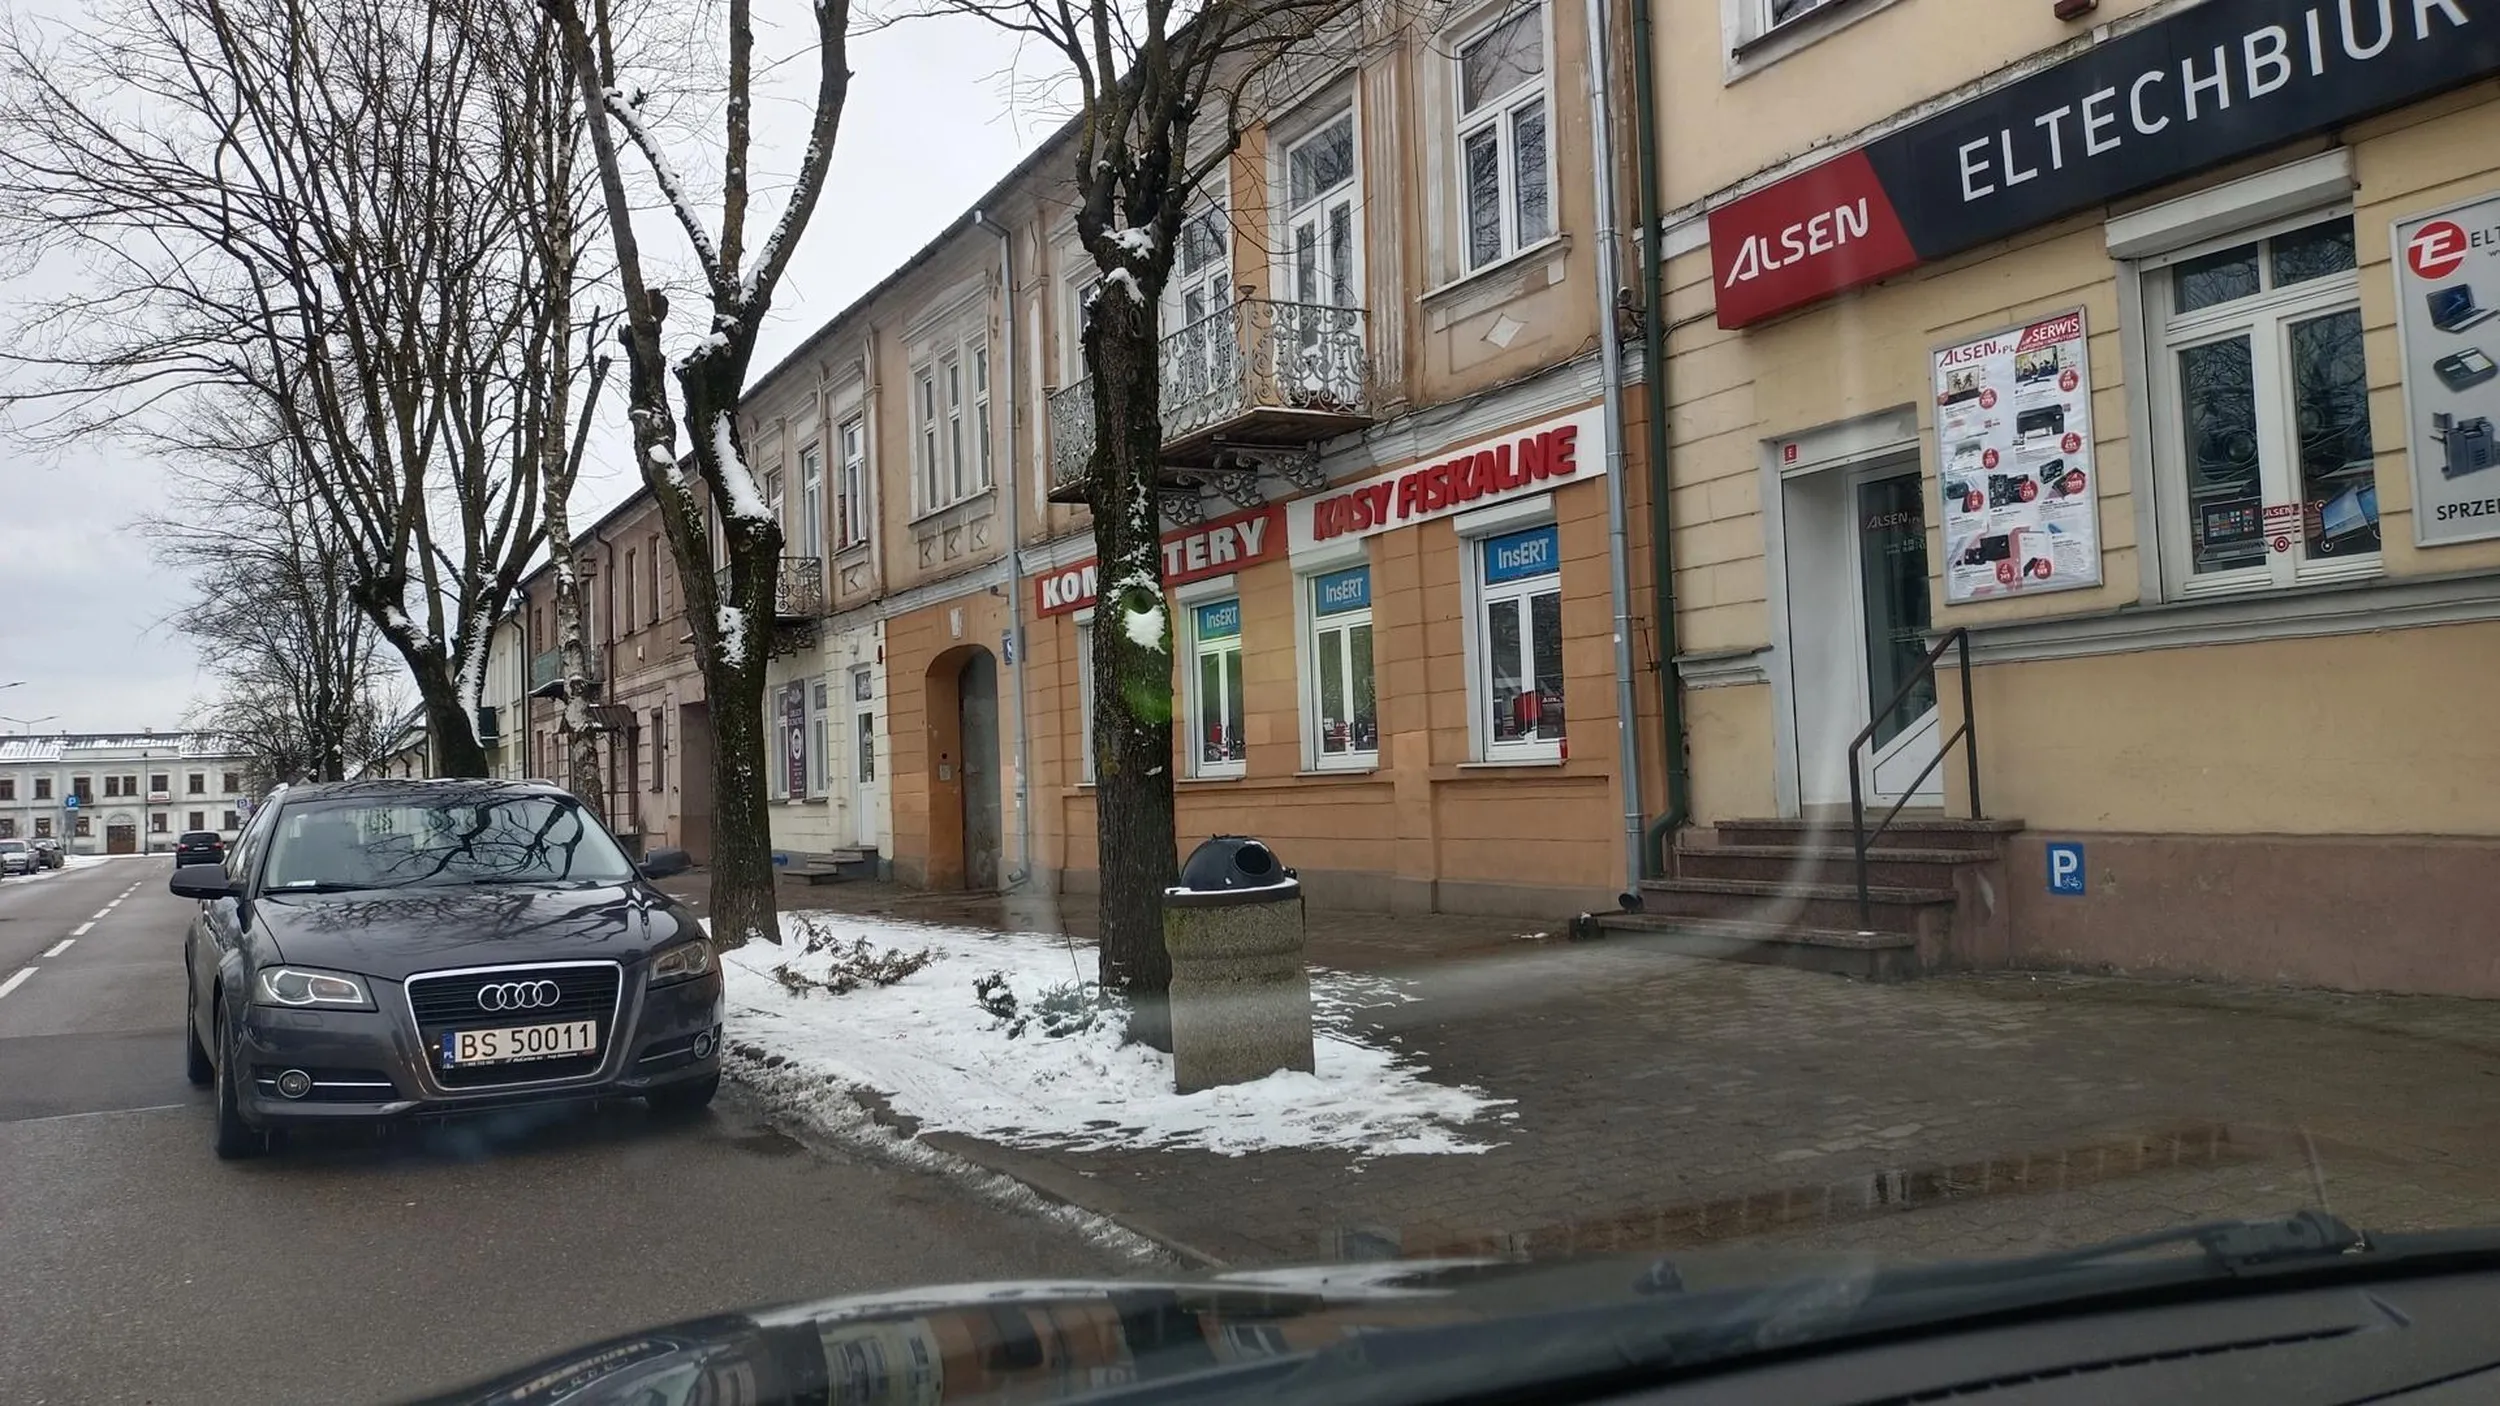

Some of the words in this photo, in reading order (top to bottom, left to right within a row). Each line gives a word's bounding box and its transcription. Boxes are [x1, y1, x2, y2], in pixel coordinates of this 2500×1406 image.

[1723, 197, 1870, 290] ALSEN
[2032, 317, 2080, 343] SERWIS
[1313, 480, 1394, 542] KASY
[1396, 425, 1578, 520] FISKALNE
[2437, 497, 2500, 521] SPRZE
[1041, 516, 1270, 610] KOMTERY
[1498, 538, 1549, 570] InsERT
[1326, 577, 1363, 603] InsERT
[1206, 606, 1237, 630] InsERT
[2053, 849, 2078, 888] P
[461, 1032, 497, 1060] BS
[511, 1023, 588, 1055] 50011
